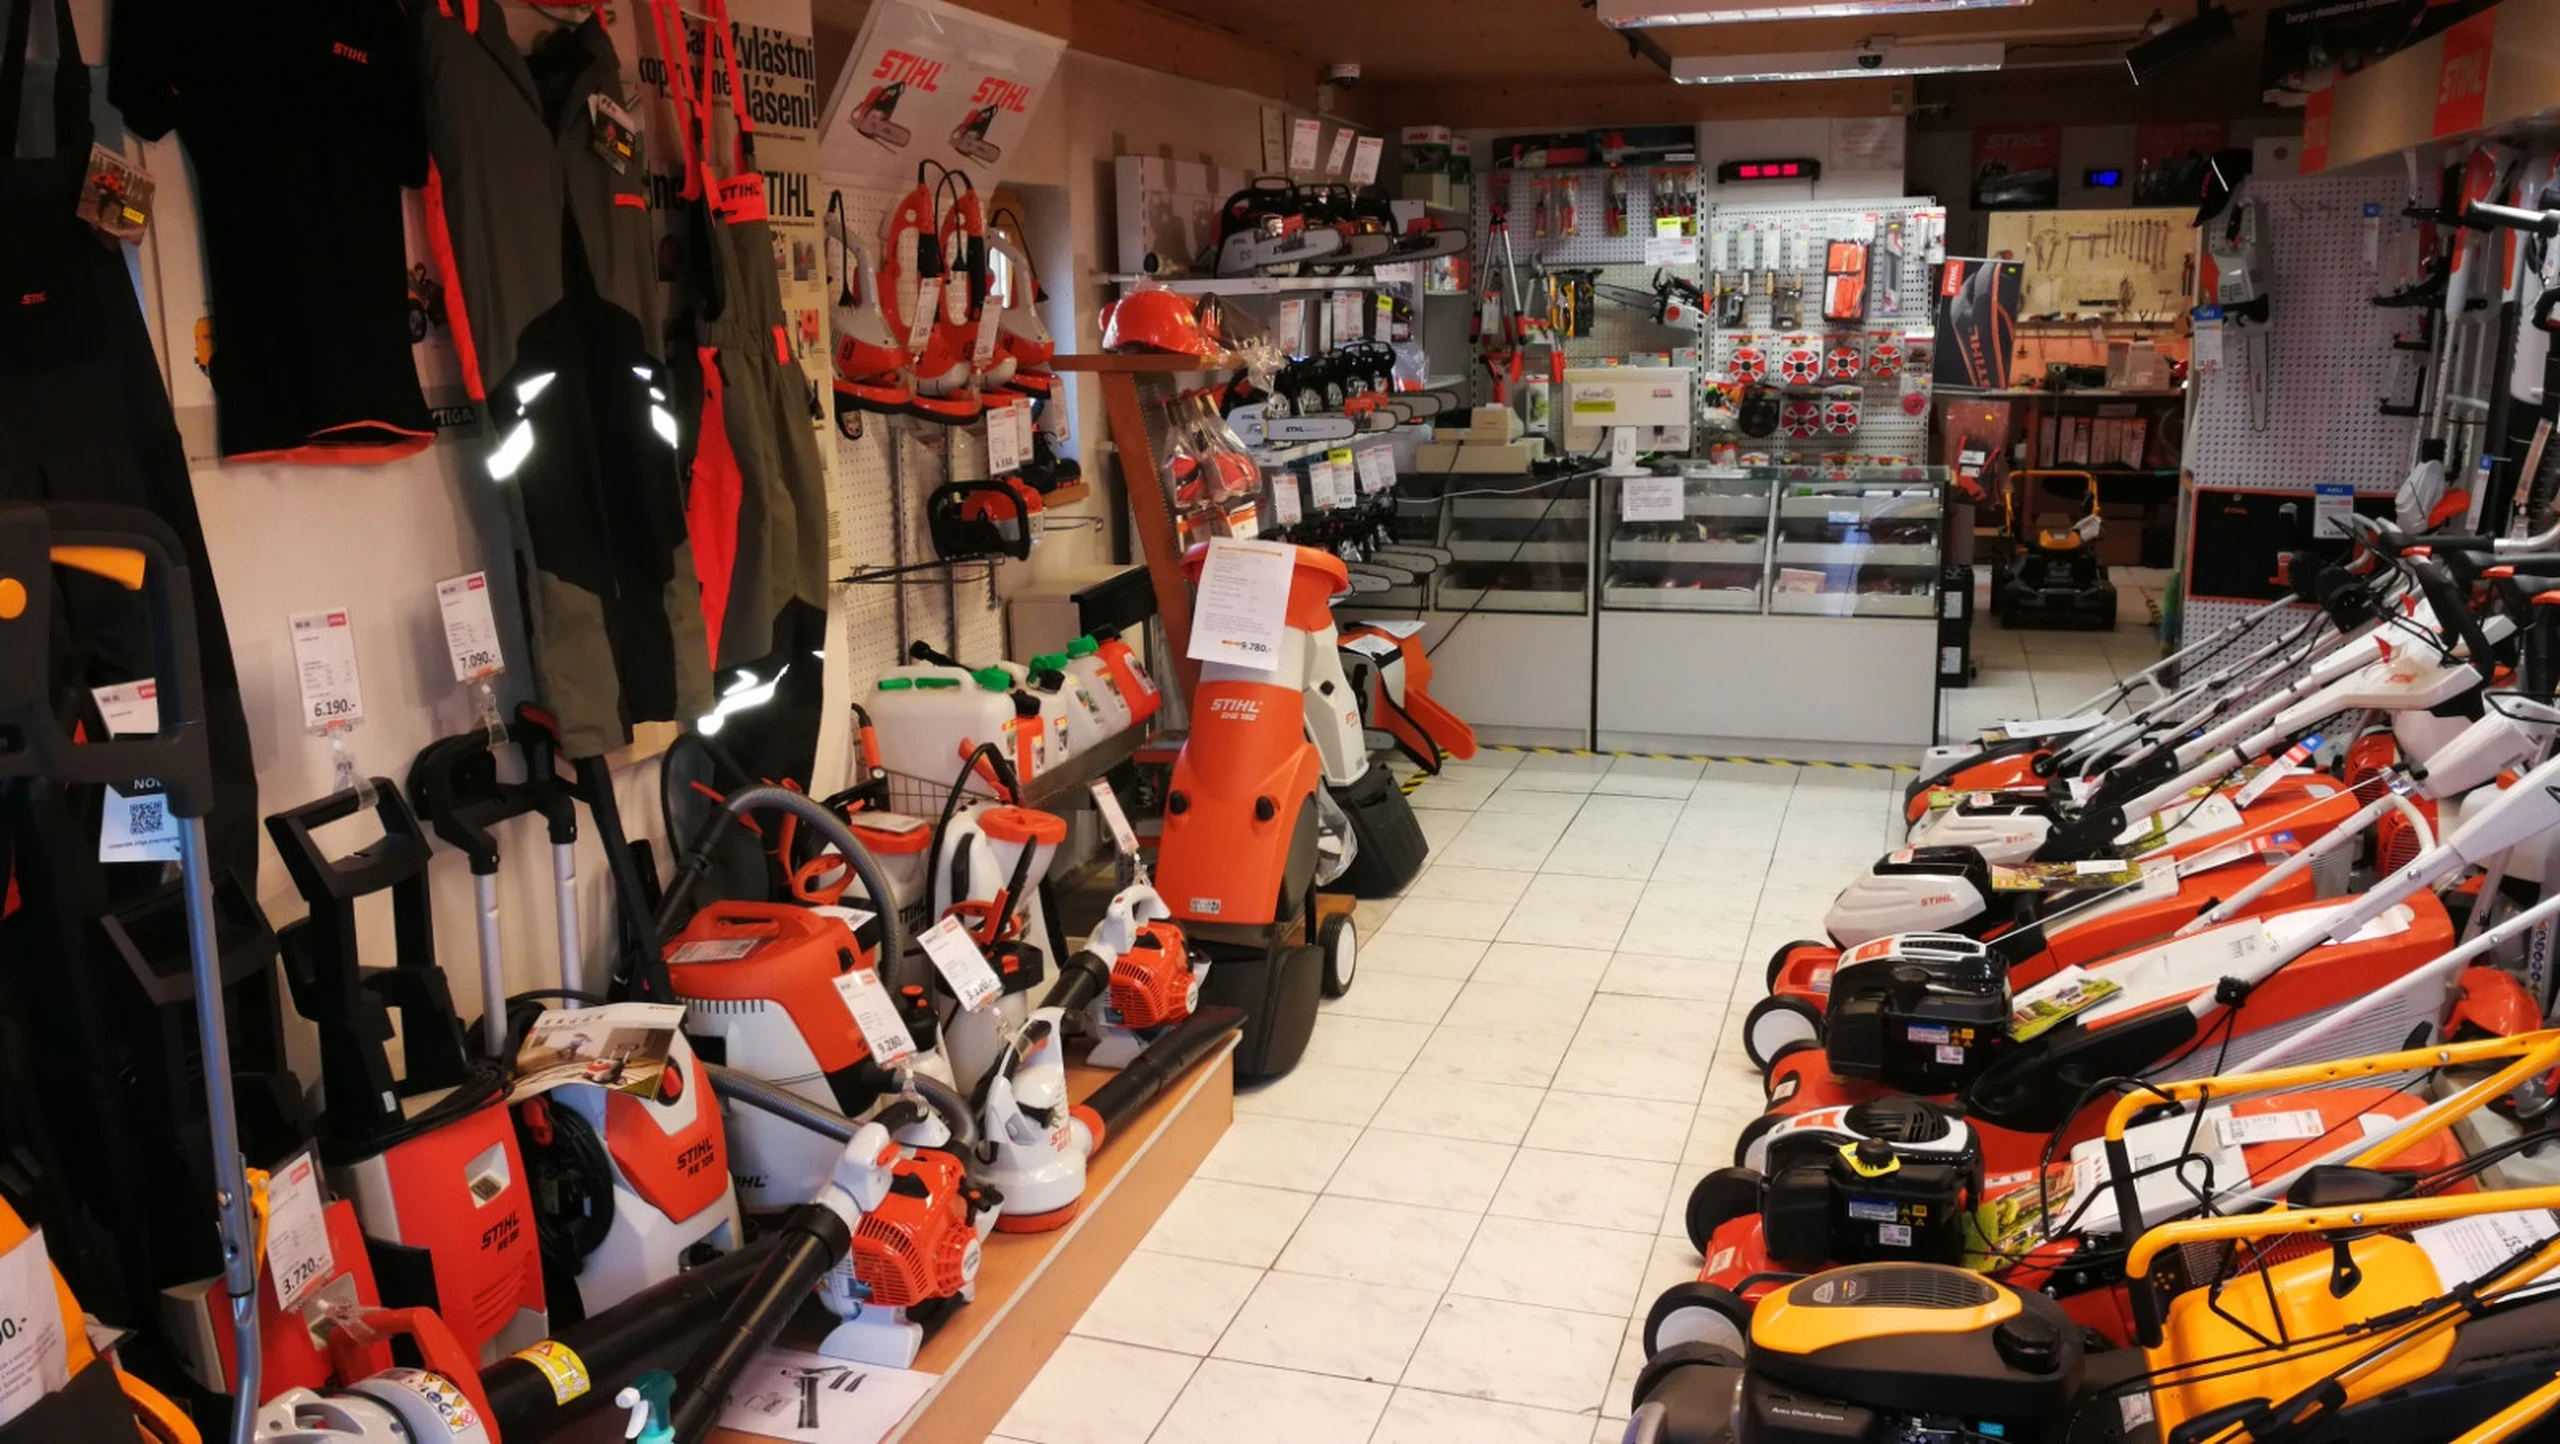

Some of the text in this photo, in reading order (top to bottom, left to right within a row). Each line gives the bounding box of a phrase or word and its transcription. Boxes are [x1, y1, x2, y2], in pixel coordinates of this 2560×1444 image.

[333, 42, 368, 64] STIHL
[872, 49, 942, 92] STIHL
[2440, 47, 2484, 104] STIHL
[743, 74, 818, 129] lášení!
[970, 76, 1030, 113] STIHL
[757, 170, 815, 217] TIHL
[1947, 263, 1960, 294] STIHL
[1968, 325, 1991, 388] STIHL
[431, 408, 475, 428] TIGA
[459, 651, 496, 669] 7.090.-
[314, 698, 356, 717] 6.190.-
[1211, 698, 1261, 713] STIHL
[1921, 895, 1953, 907] STIHL
[677, 1138, 713, 1171] STIHL
[481, 1210, 519, 1251] STIHL
[284, 1255, 324, 1295] 3.720.-
